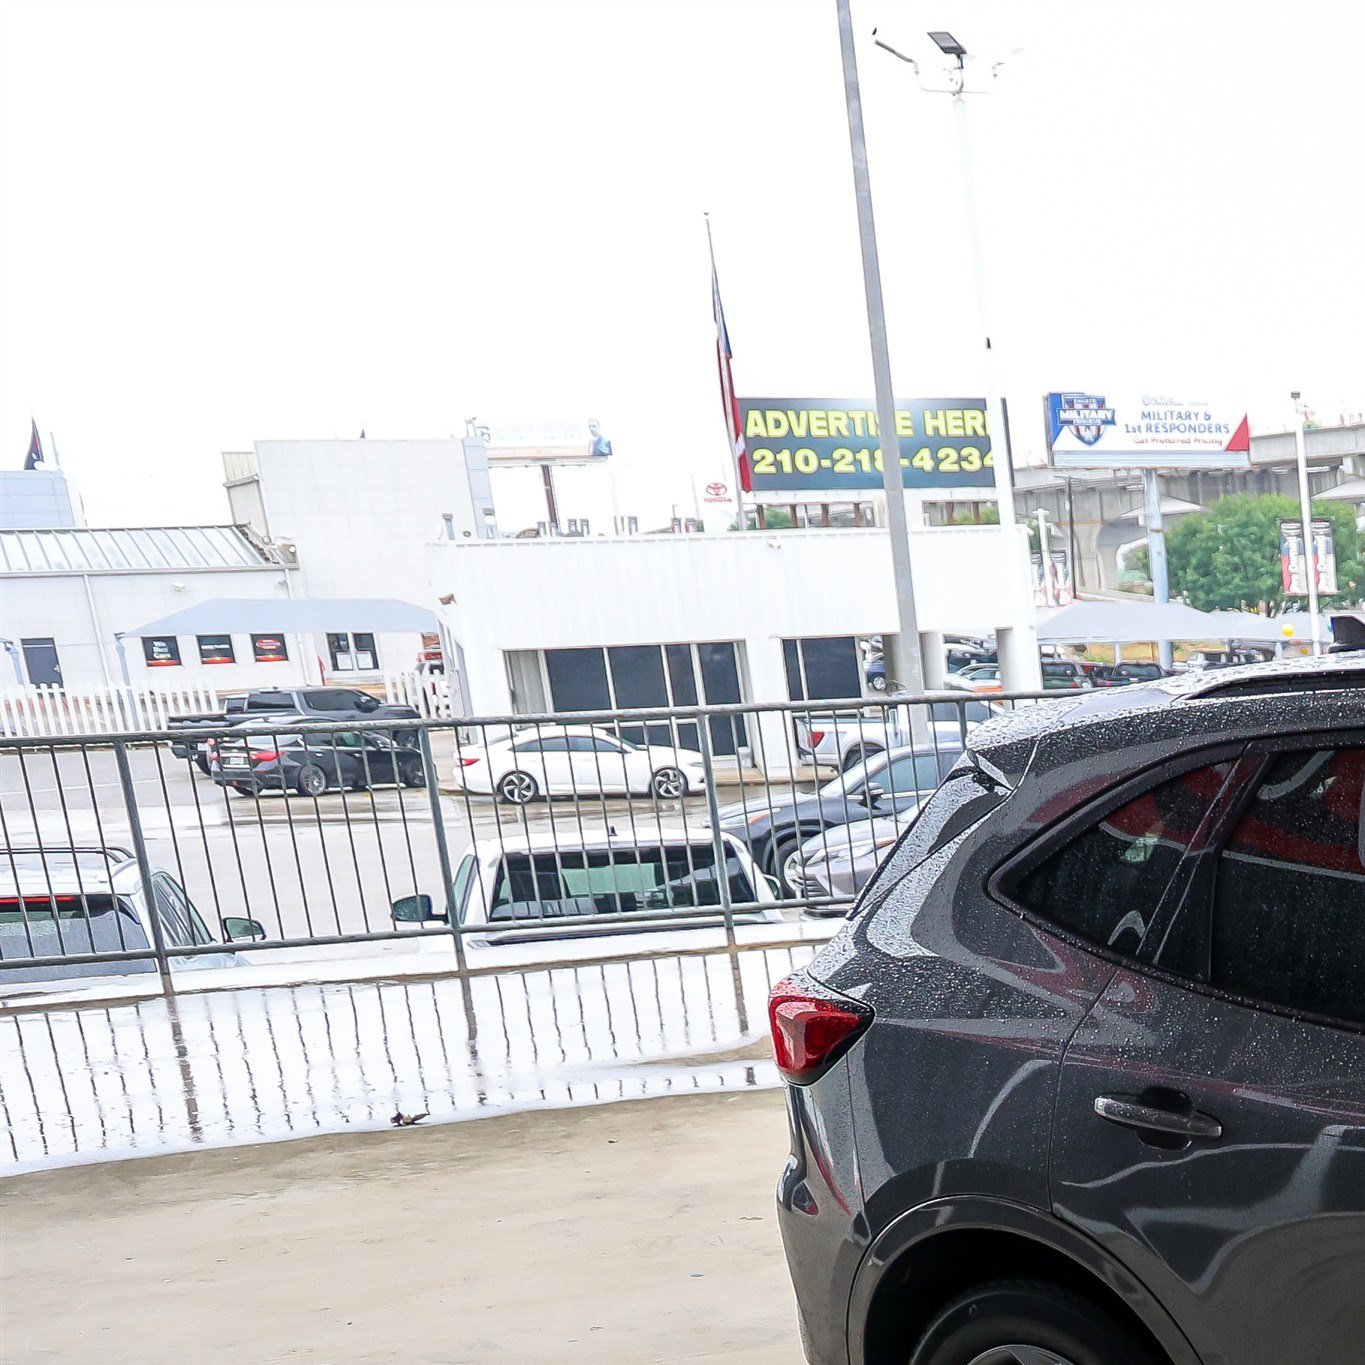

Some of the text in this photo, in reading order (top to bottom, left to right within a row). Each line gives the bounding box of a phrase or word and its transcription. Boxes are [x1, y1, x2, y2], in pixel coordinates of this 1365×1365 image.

[1141, 410, 1199, 421] MILITARY
[746, 409, 991, 438] ADVERTIE HER
[1124, 422, 1230, 434] 1st RESPONDERS
